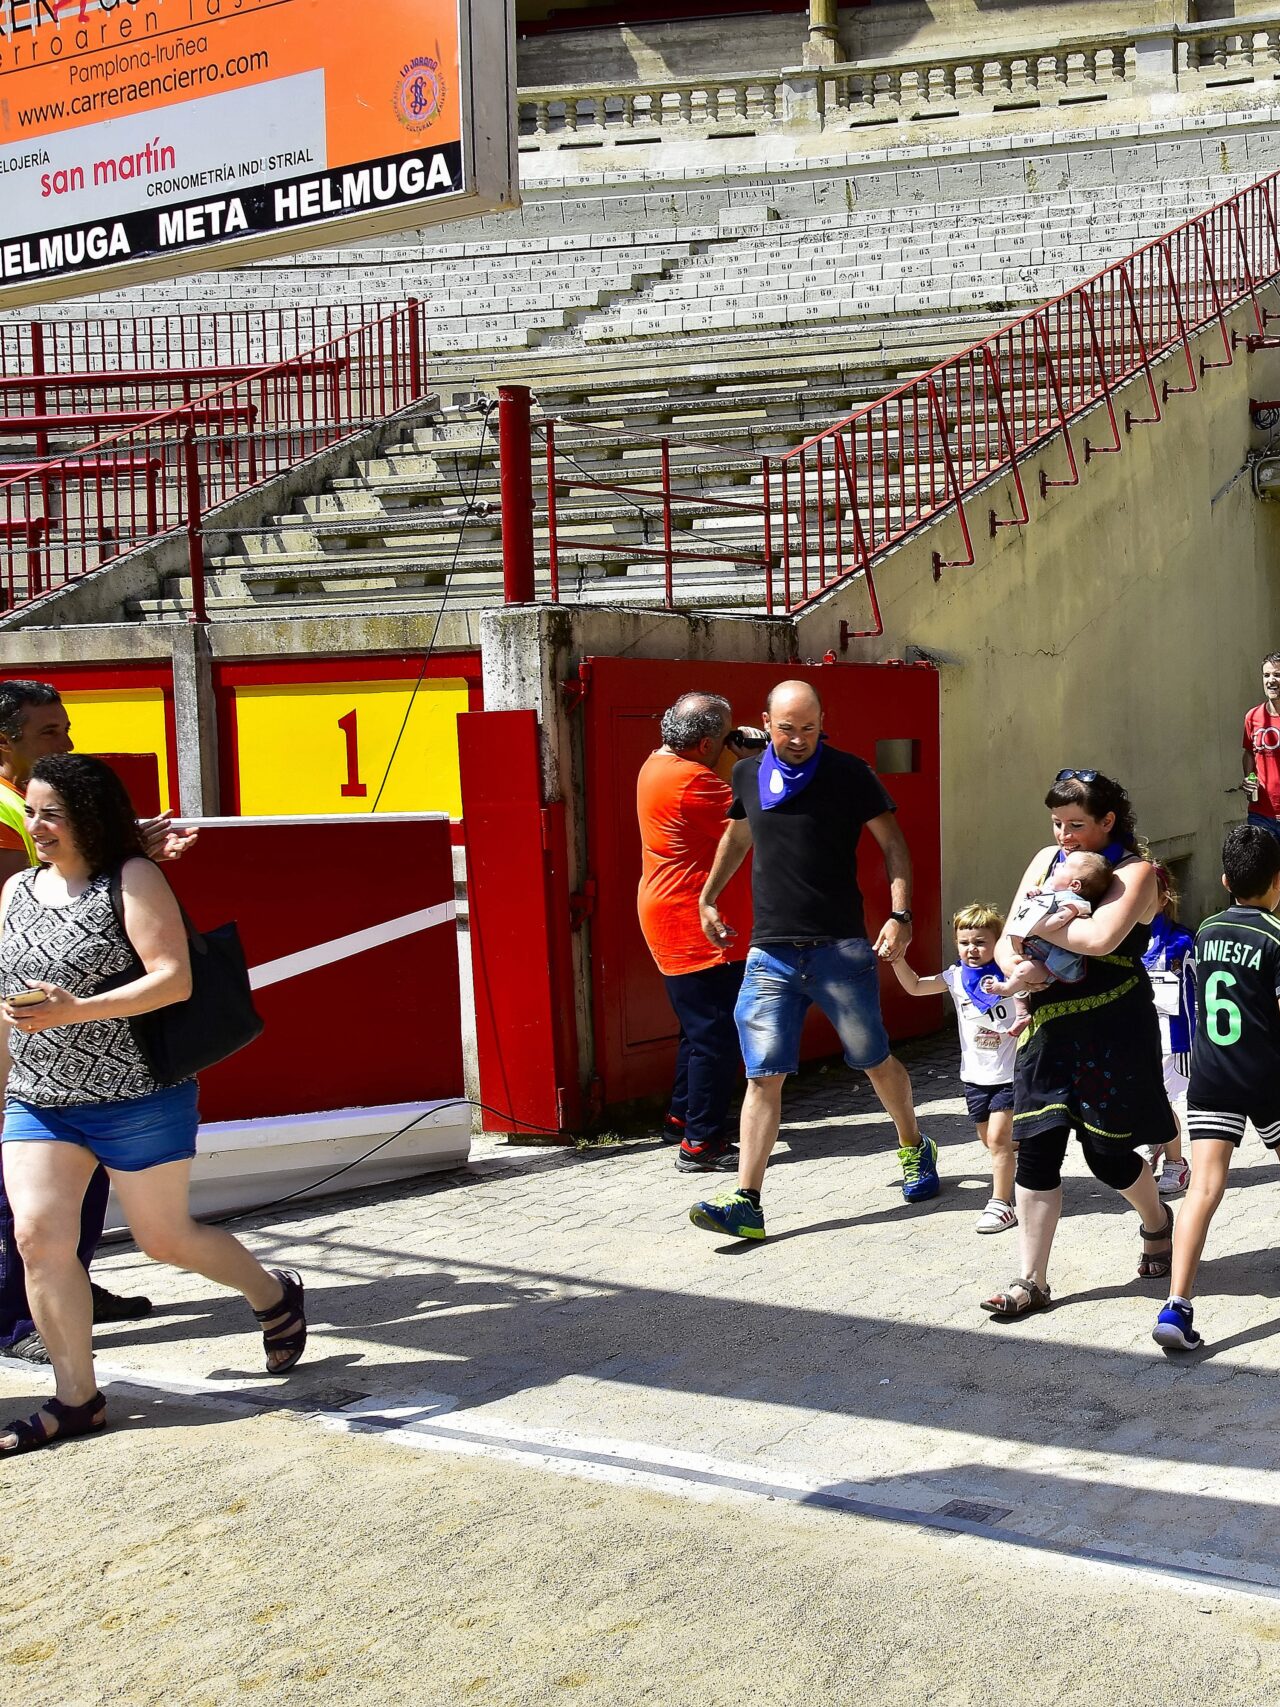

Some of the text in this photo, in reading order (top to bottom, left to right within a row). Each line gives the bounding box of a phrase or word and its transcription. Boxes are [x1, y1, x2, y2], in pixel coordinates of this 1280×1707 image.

[0, 11, 157, 68] rroaren
[69, 36, 208, 85] Pamplona-Iruñea
[18, 50, 268, 127] www.carreraencierro.com
[41, 137, 176, 198] san martín
[147, 163, 236, 197] CRONOMETRÍA
[0, 152, 453, 279] ELMUGA META HELMUGA
[337, 708, 367, 798] 1
[1203, 939, 1262, 971] INIESTA
[983, 1005, 1007, 1022] 10
[1205, 970, 1242, 1046] 6
